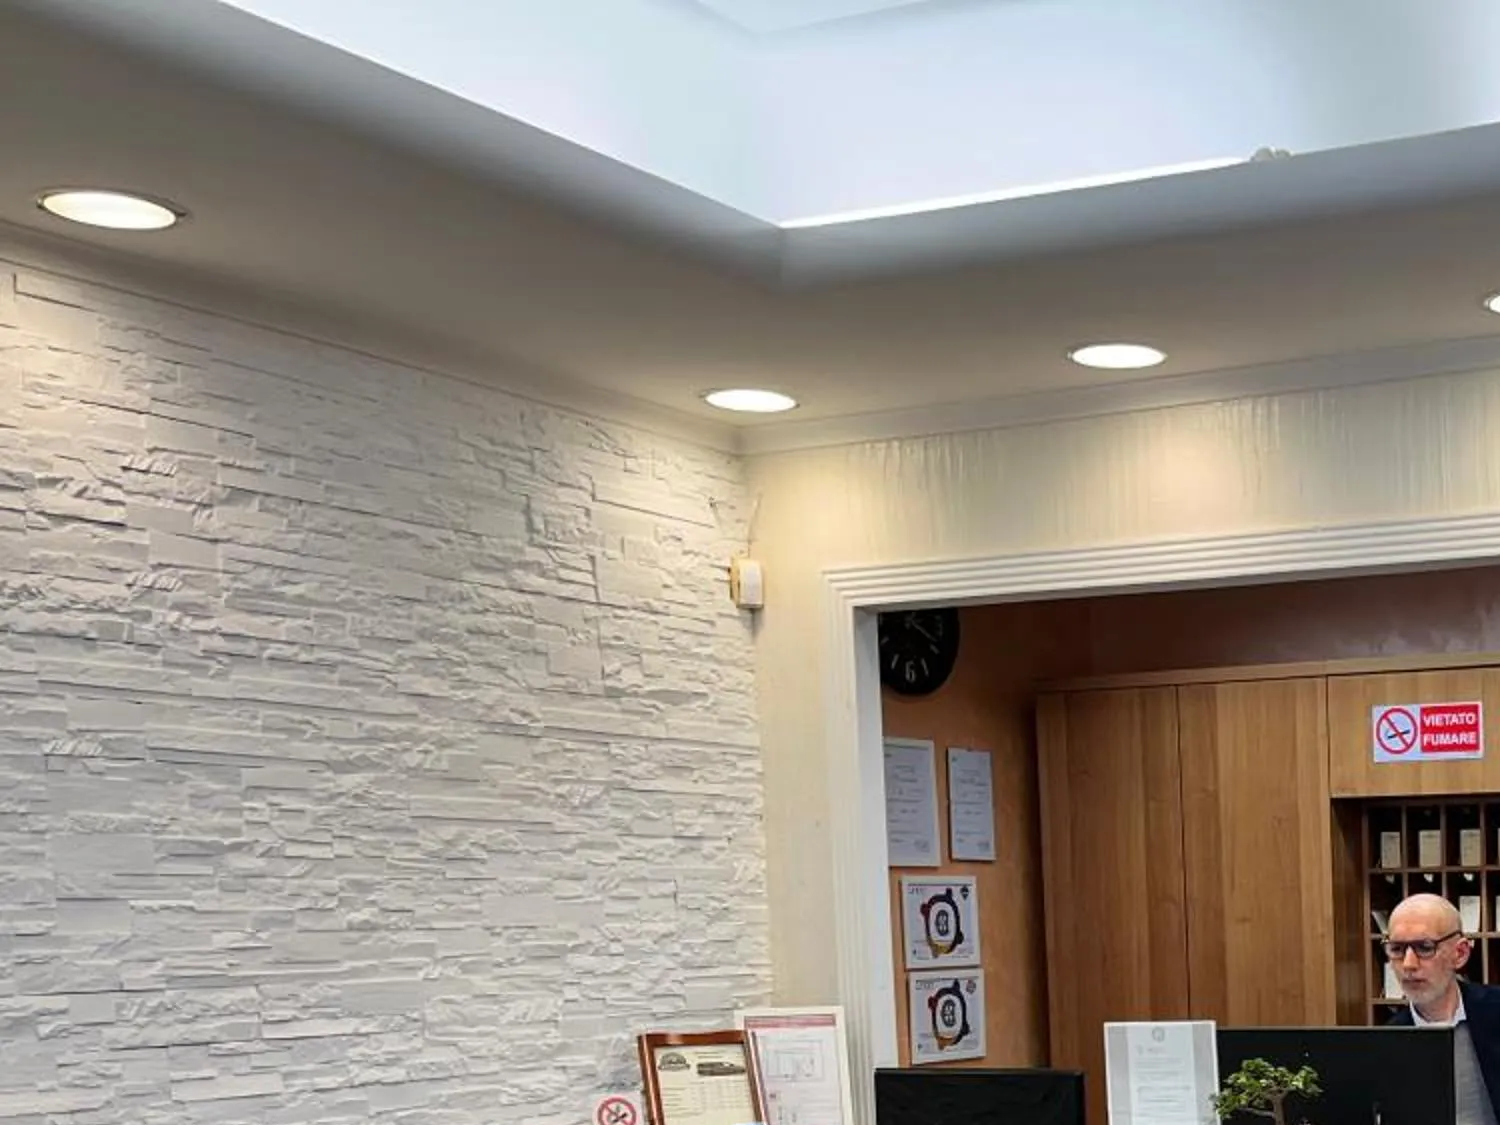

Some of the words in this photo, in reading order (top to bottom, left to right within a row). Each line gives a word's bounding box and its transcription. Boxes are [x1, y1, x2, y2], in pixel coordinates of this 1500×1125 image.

[905, 660, 917, 682] 6
[1423, 712, 1476, 727] VIETATO
[1423, 731, 1477, 746] FUMARE
